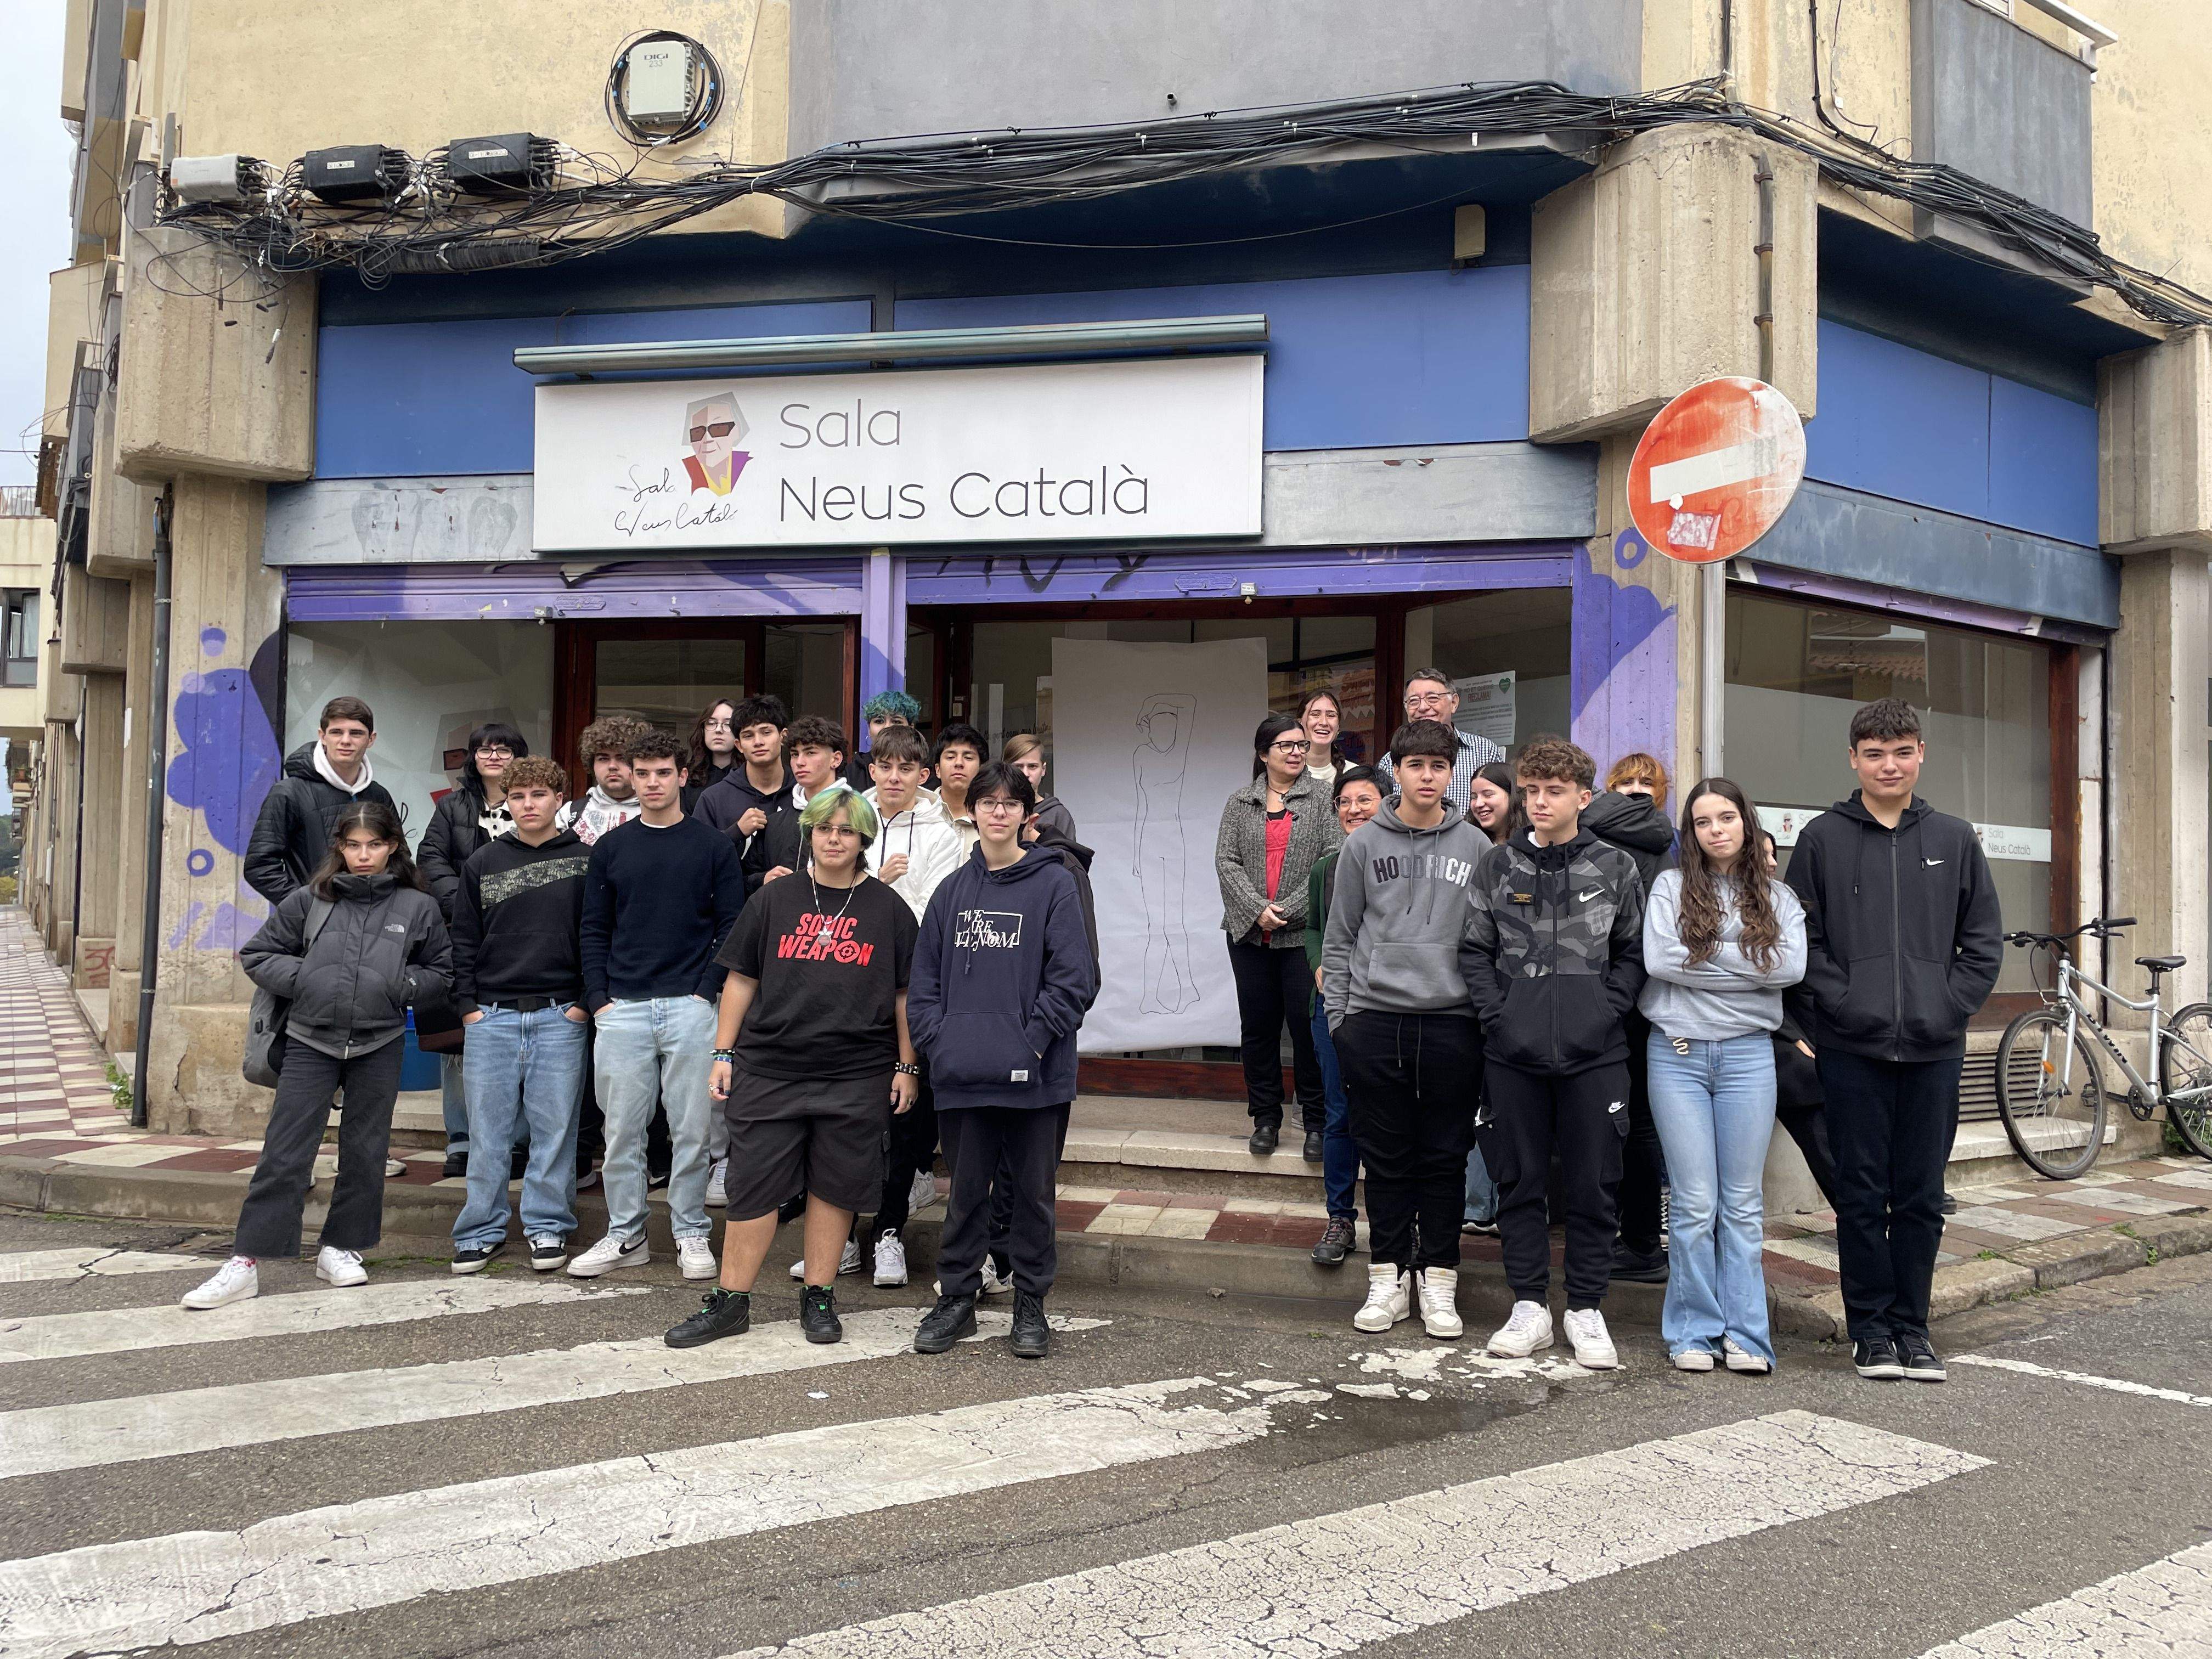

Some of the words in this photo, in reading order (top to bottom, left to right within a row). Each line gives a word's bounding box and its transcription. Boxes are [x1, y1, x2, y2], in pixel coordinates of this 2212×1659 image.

[780, 398, 900, 449] Sala
[780, 477, 926, 522] Neus
[950, 464, 1148, 518] Català
[1988, 828, 2004, 839] Sala
[1988, 843, 2006, 854] Neus
[2008, 844, 2031, 855] Català
